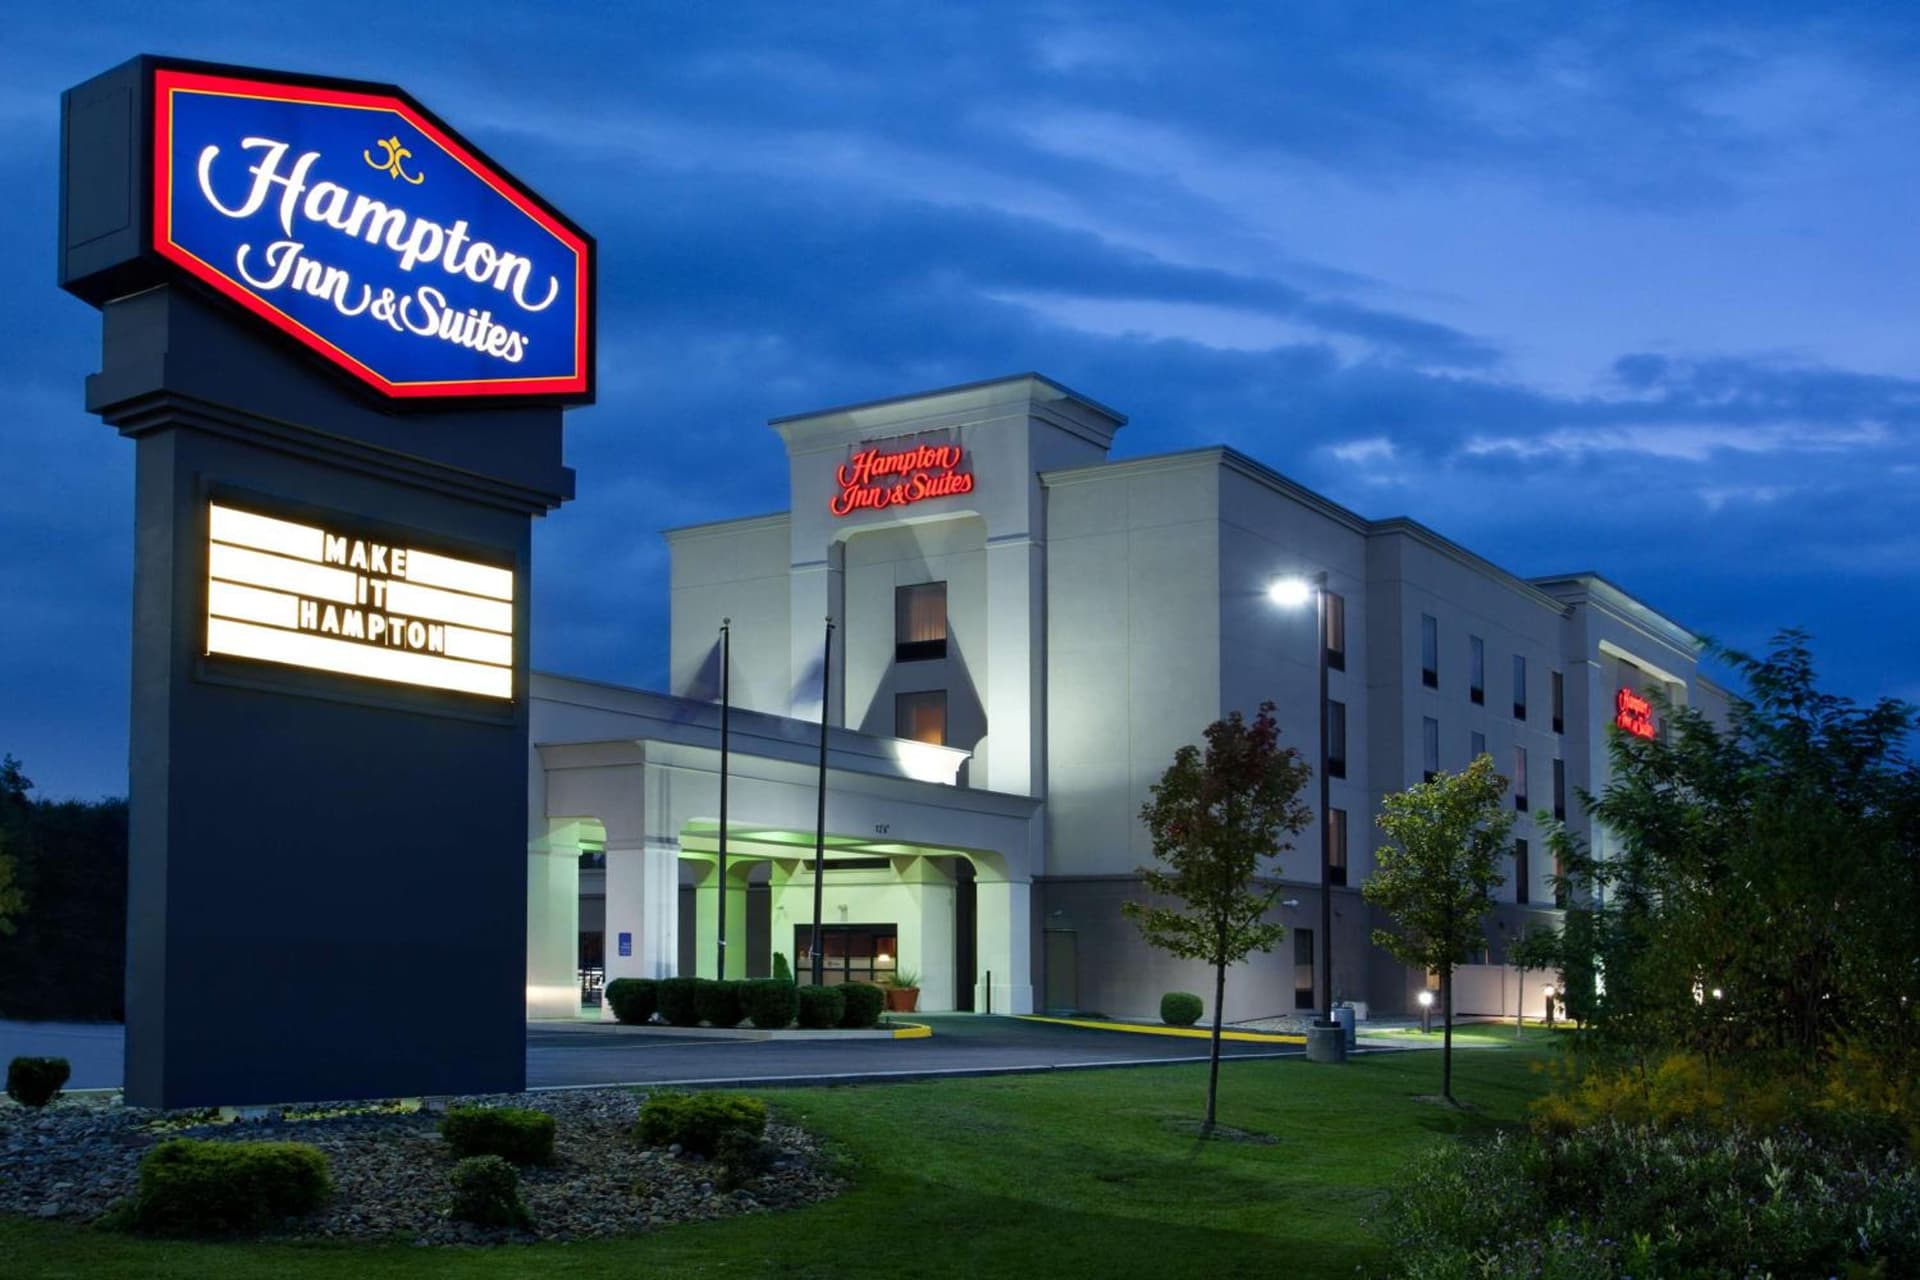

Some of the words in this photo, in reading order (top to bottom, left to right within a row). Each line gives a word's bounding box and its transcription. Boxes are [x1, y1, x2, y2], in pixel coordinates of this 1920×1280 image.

[198, 136, 559, 312] Hampton
[236, 240, 372, 316] Inn
[371, 287, 404, 332] &
[401, 285, 524, 363] Suites
[838, 445, 962, 487] Hampton
[830, 484, 892, 516] Inn
[890, 483, 906, 505] &
[904, 470, 974, 501] Suites
[325, 533, 407, 578] MAKE
[357, 576, 388, 608] IT
[300, 599, 445, 653] HAMPTON
